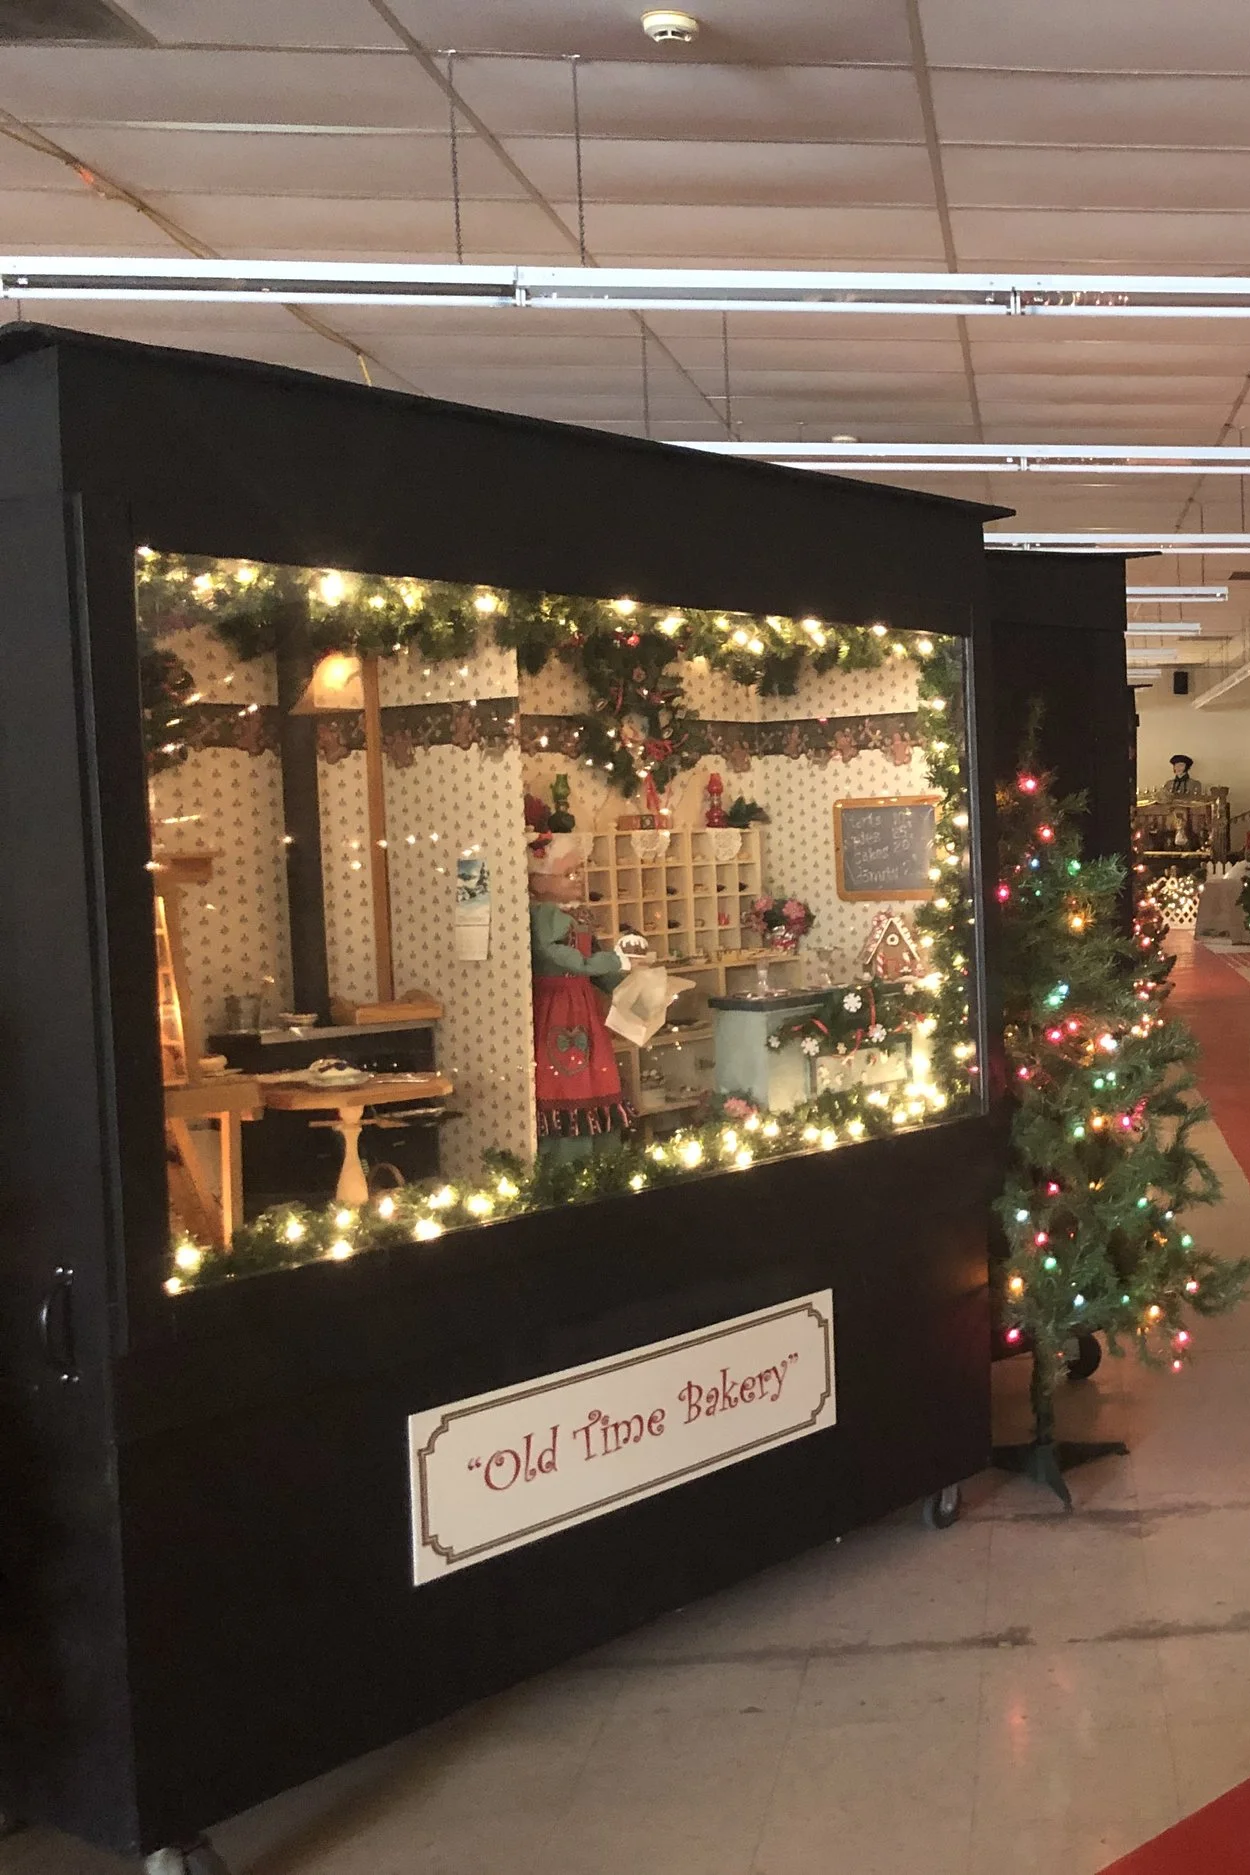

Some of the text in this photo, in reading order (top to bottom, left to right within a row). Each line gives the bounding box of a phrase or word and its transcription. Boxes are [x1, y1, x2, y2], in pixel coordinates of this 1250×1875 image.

[466, 1352, 799, 1491] “Old Time Bakery”
